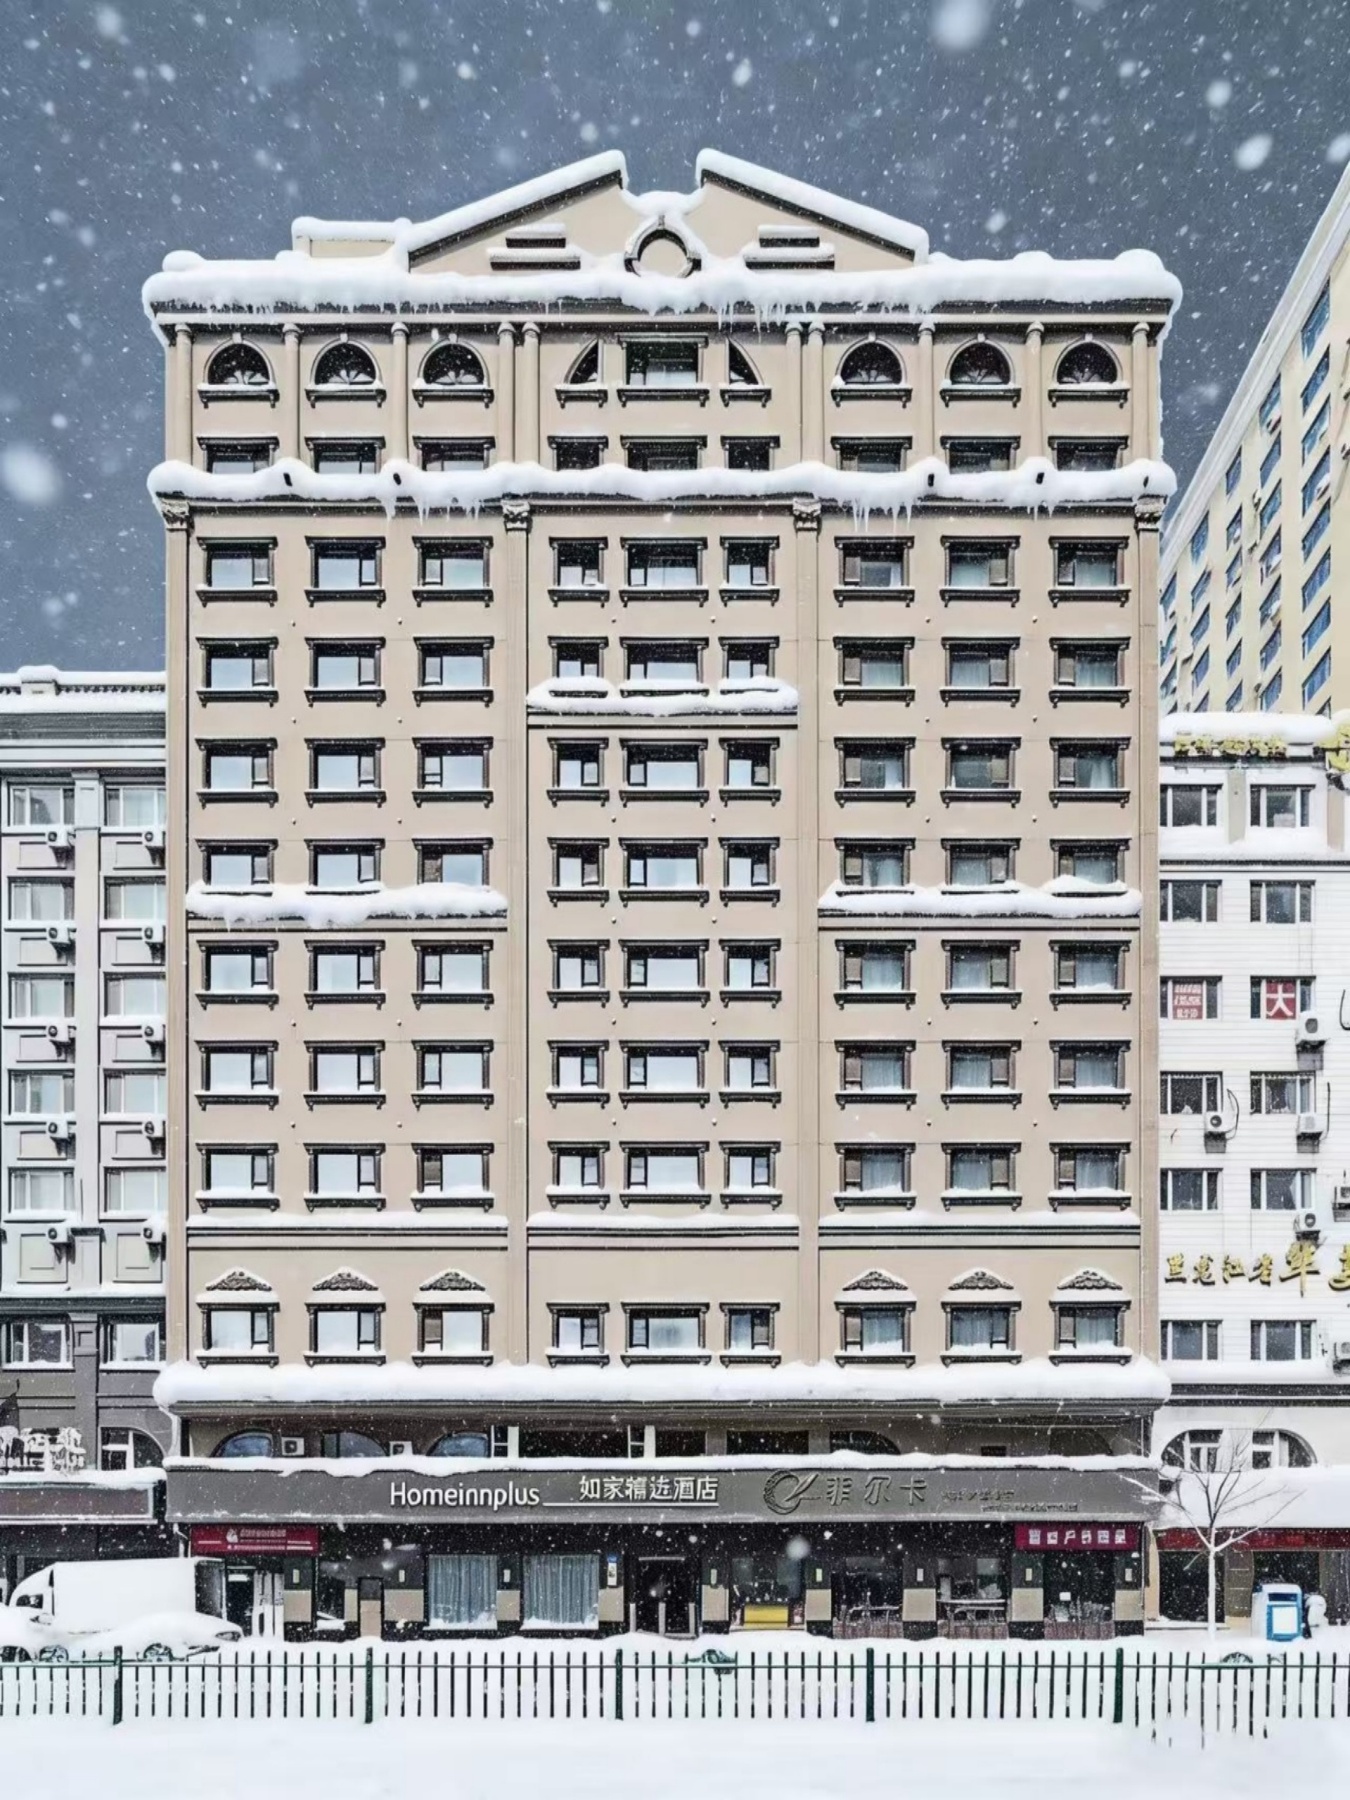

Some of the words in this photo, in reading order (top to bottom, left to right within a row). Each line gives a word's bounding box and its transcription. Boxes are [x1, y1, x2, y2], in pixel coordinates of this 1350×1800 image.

[1266, 984, 1295, 1016] 大
[390, 1481, 540, 1511] Homeinnplus
[826, 1475, 928, 1505] 菲尔卡
